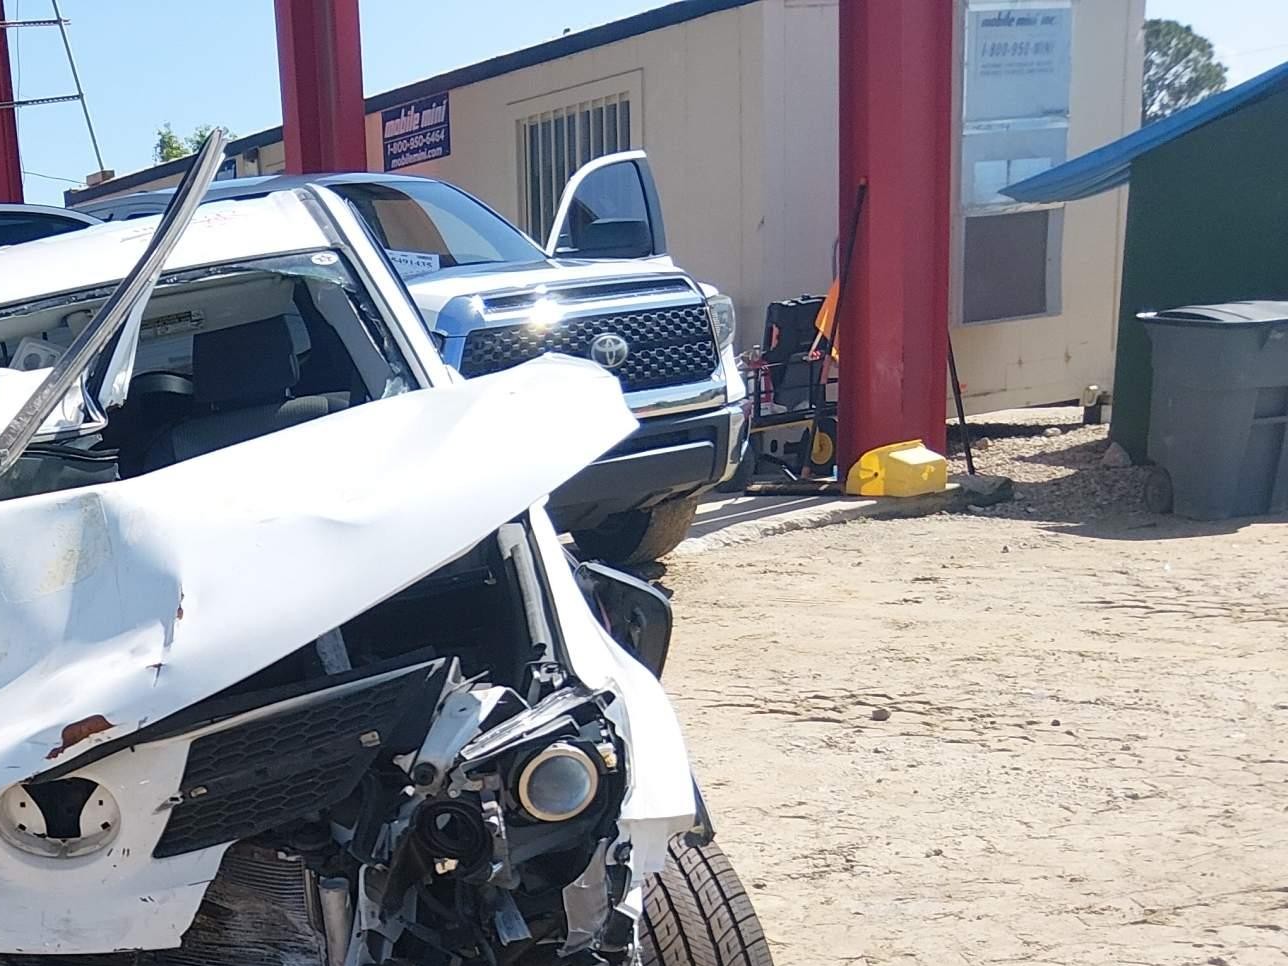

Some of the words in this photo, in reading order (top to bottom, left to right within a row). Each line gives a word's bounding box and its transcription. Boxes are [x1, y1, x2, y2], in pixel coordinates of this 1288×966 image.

[384, 105, 420, 138] mobile
[420, 100, 447, 128] mini
[387, 128, 445, 156] 1-800-950-6464
[390, 147, 443, 168] mobilemini.com
